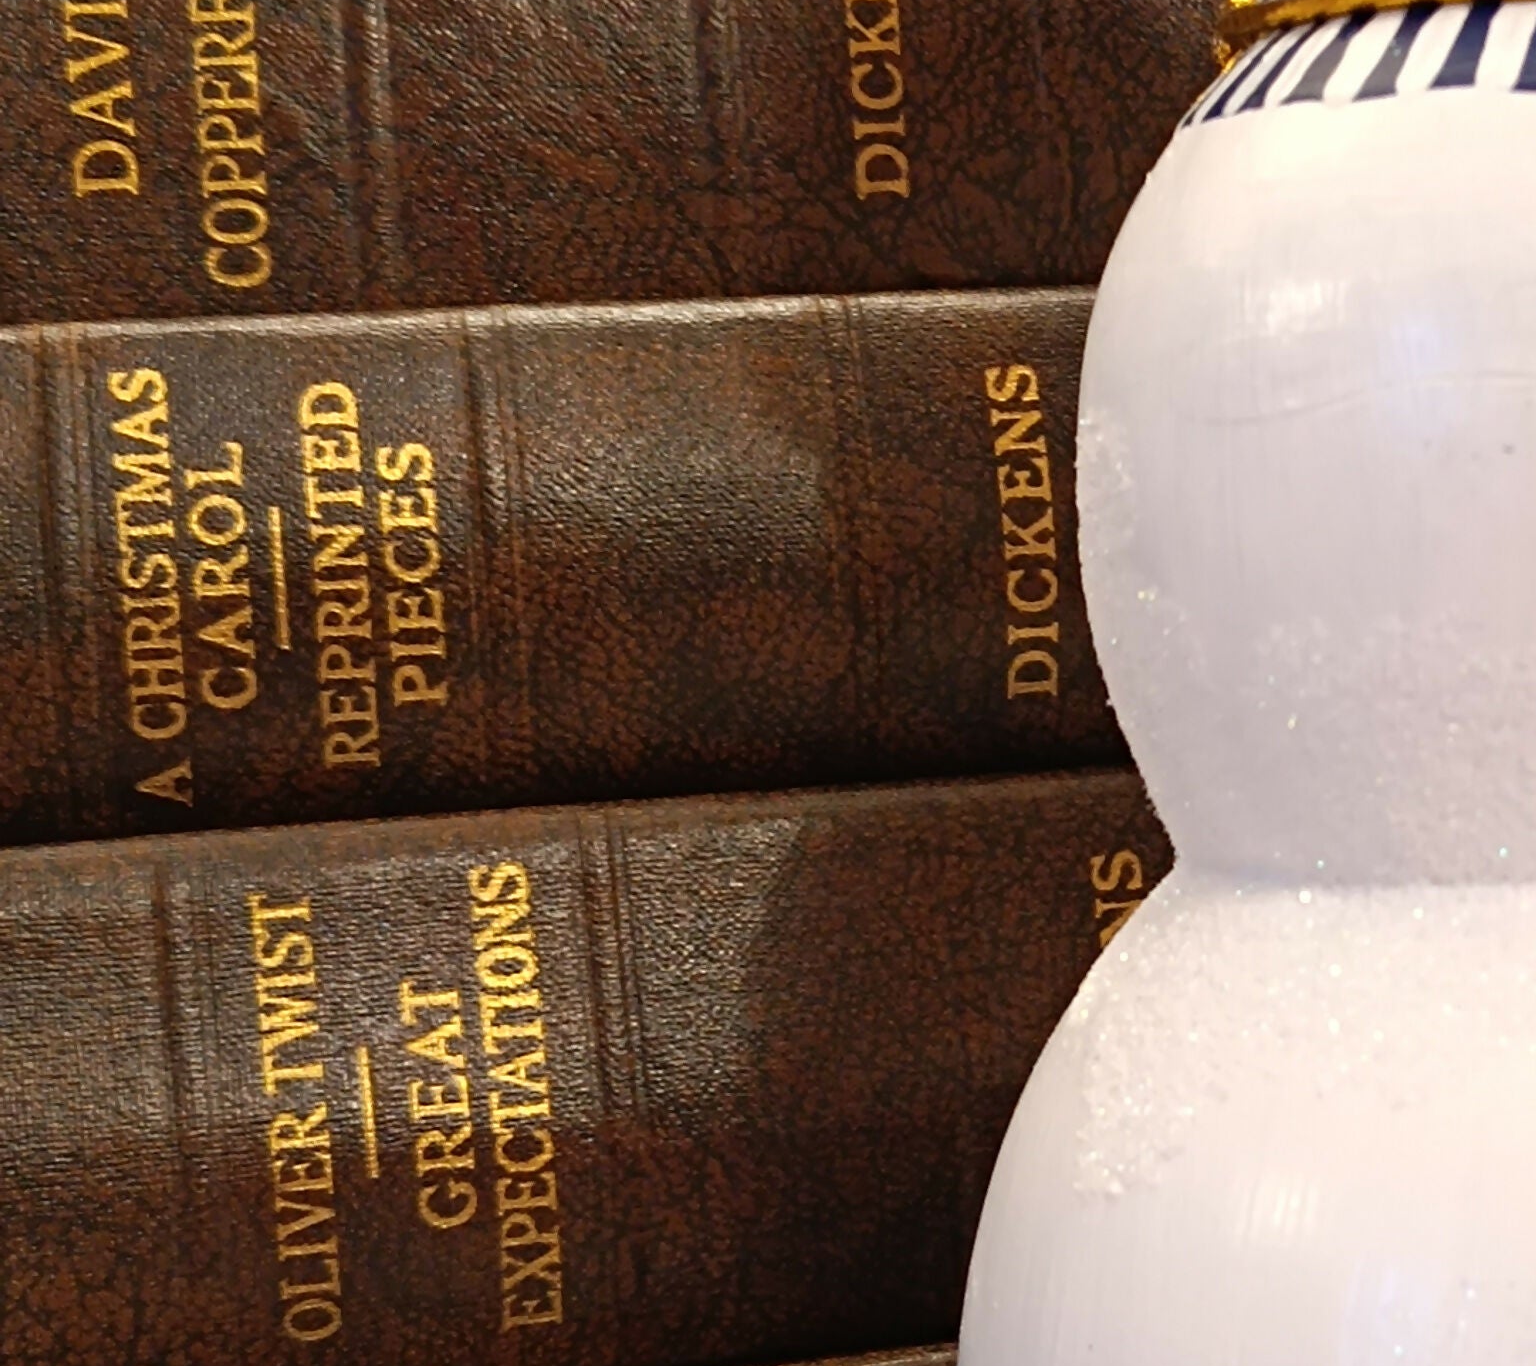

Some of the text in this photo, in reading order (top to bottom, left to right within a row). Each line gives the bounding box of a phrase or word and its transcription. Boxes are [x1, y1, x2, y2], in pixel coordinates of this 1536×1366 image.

[107, 367, 193, 807] A CHRISTMAS
[185, 441, 259, 710] CAROL
[301, 380, 382, 768] REPRINTED
[376, 442, 449, 707] PIECES
[985, 364, 1060, 700] DICKENS
[245, 892, 343, 1341] OLIVER TWIST
[401, 980, 478, 1230] GREAT
[468, 861, 563, 1332] EXPECTATIONS
